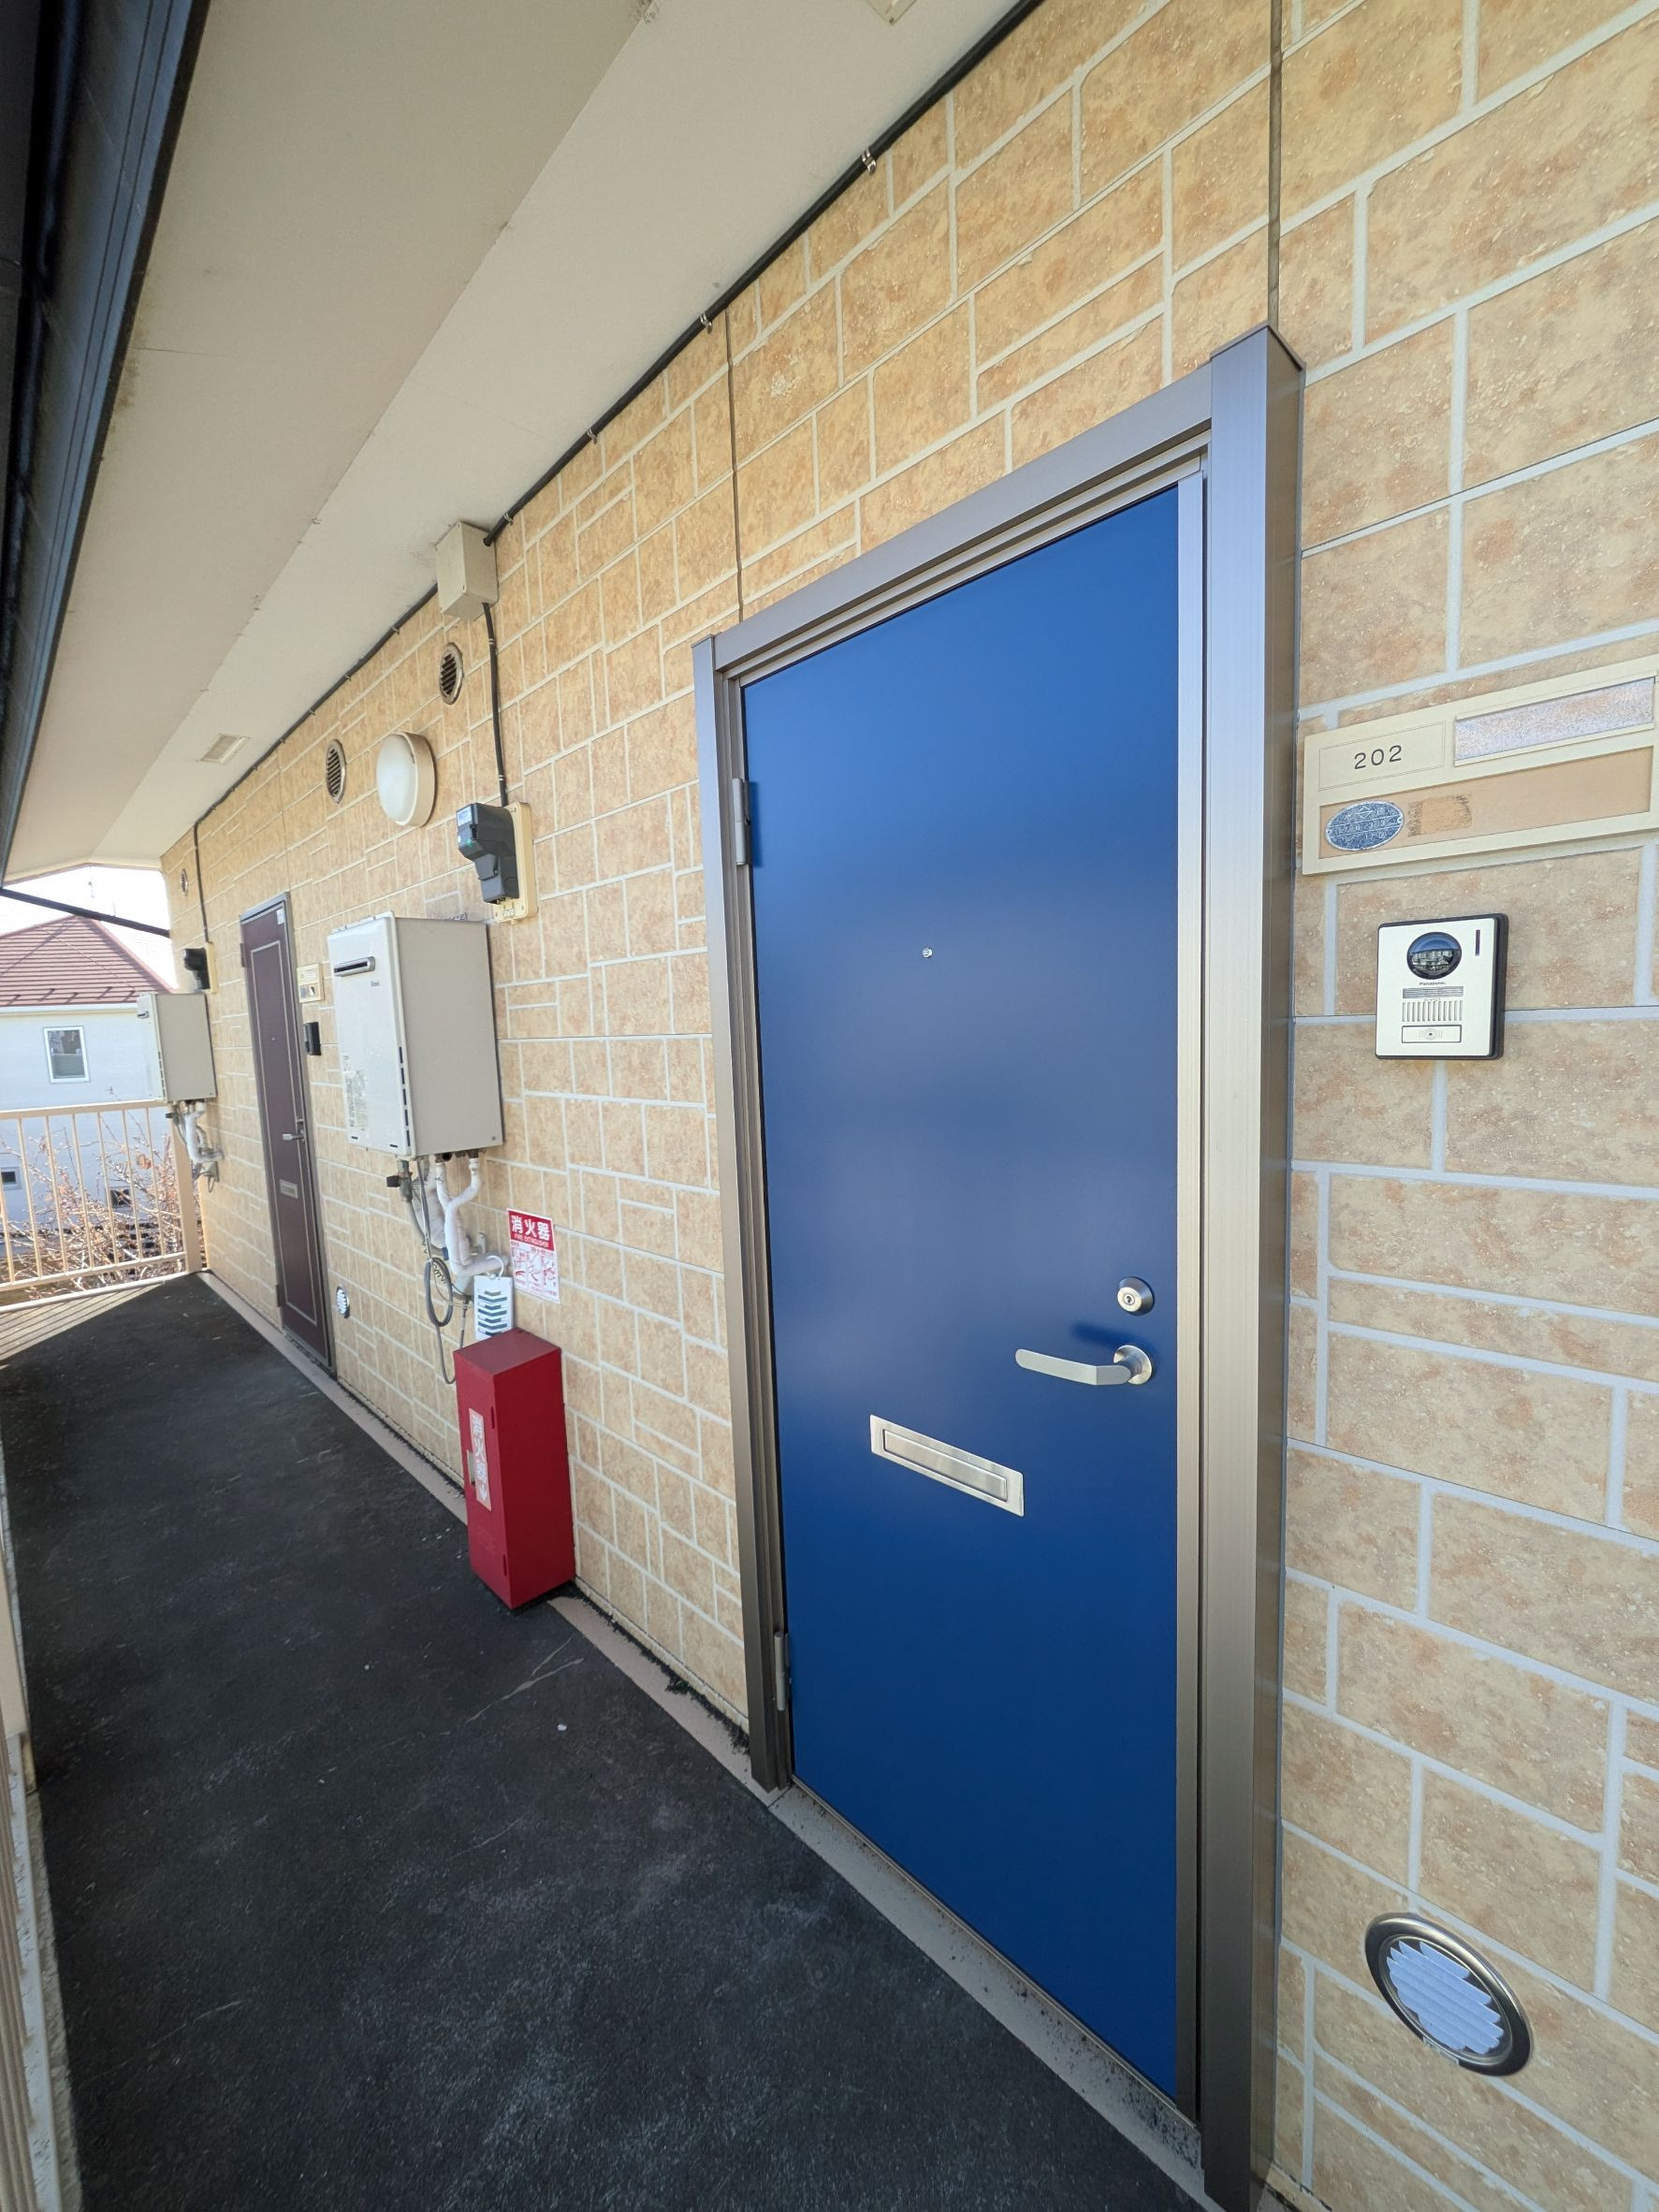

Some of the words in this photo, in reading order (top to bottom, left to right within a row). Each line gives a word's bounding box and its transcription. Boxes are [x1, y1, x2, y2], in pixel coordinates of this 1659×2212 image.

[1354, 745, 1402, 769] 202
[511, 1215, 550, 1242] 消火器
[472, 1414, 488, 1483] 消火器
